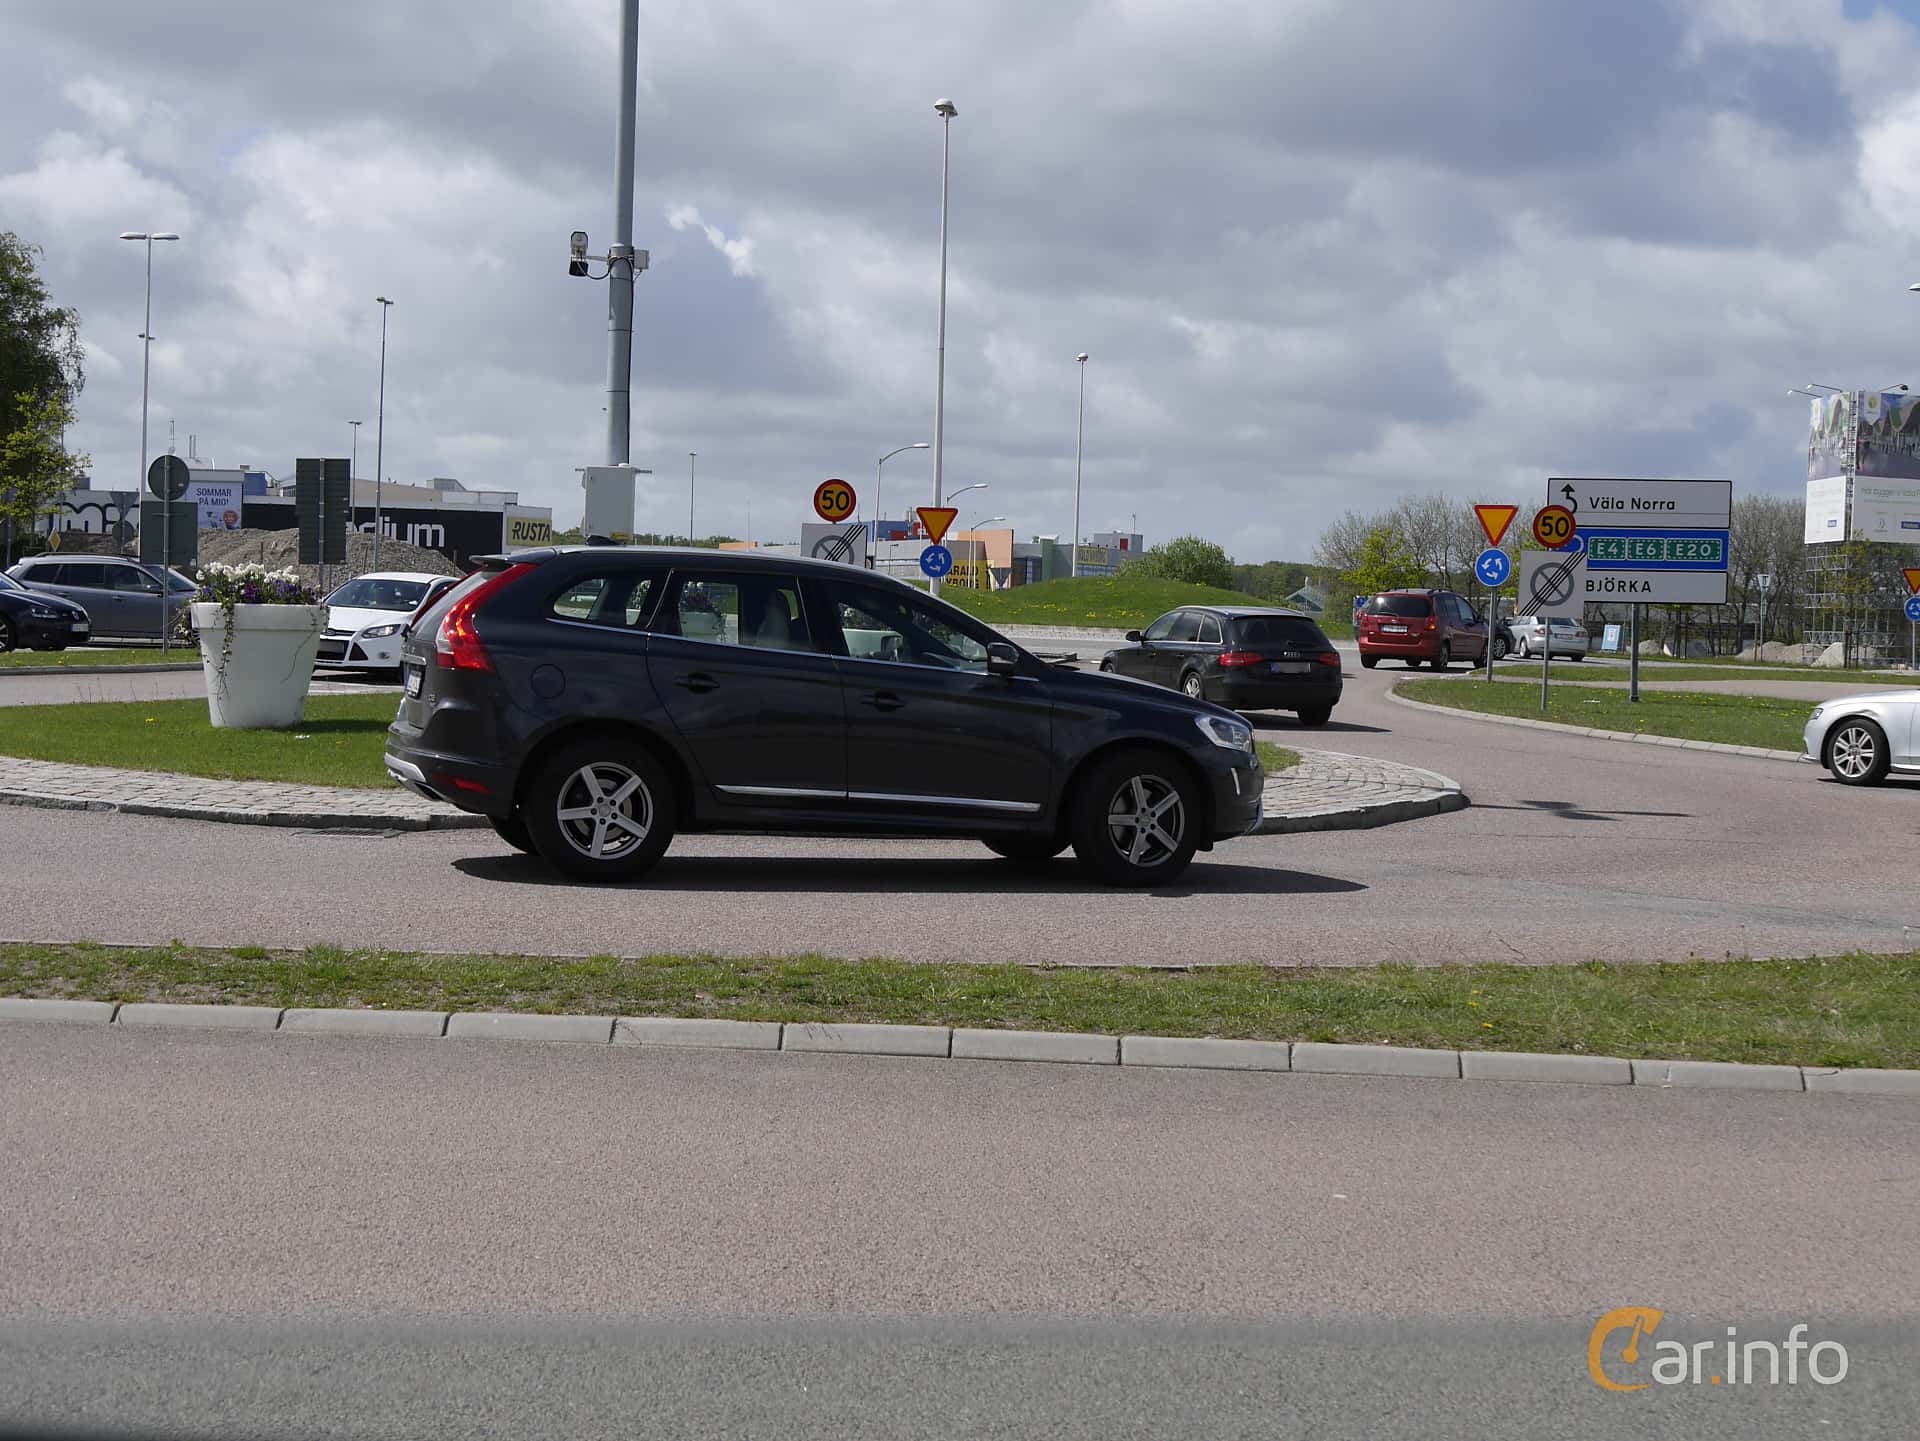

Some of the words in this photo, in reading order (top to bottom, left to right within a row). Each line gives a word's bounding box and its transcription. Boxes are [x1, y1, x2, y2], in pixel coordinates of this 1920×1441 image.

[196, 487, 232, 497] SOMMAR
[822, 489, 850, 511] 50
[199, 497, 209, 506] PÅ
[1589, 496, 1625, 510] Väla
[1631, 497, 1676, 511] Norra
[511, 520, 551, 542] RUSTA
[1541, 516, 1570, 537] 50
[1596, 542, 1618, 555] E4
[1635, 543, 1656, 556] E6
[1675, 544, 1712, 557] E20
[1586, 576, 1652, 593] BJÖRKA
